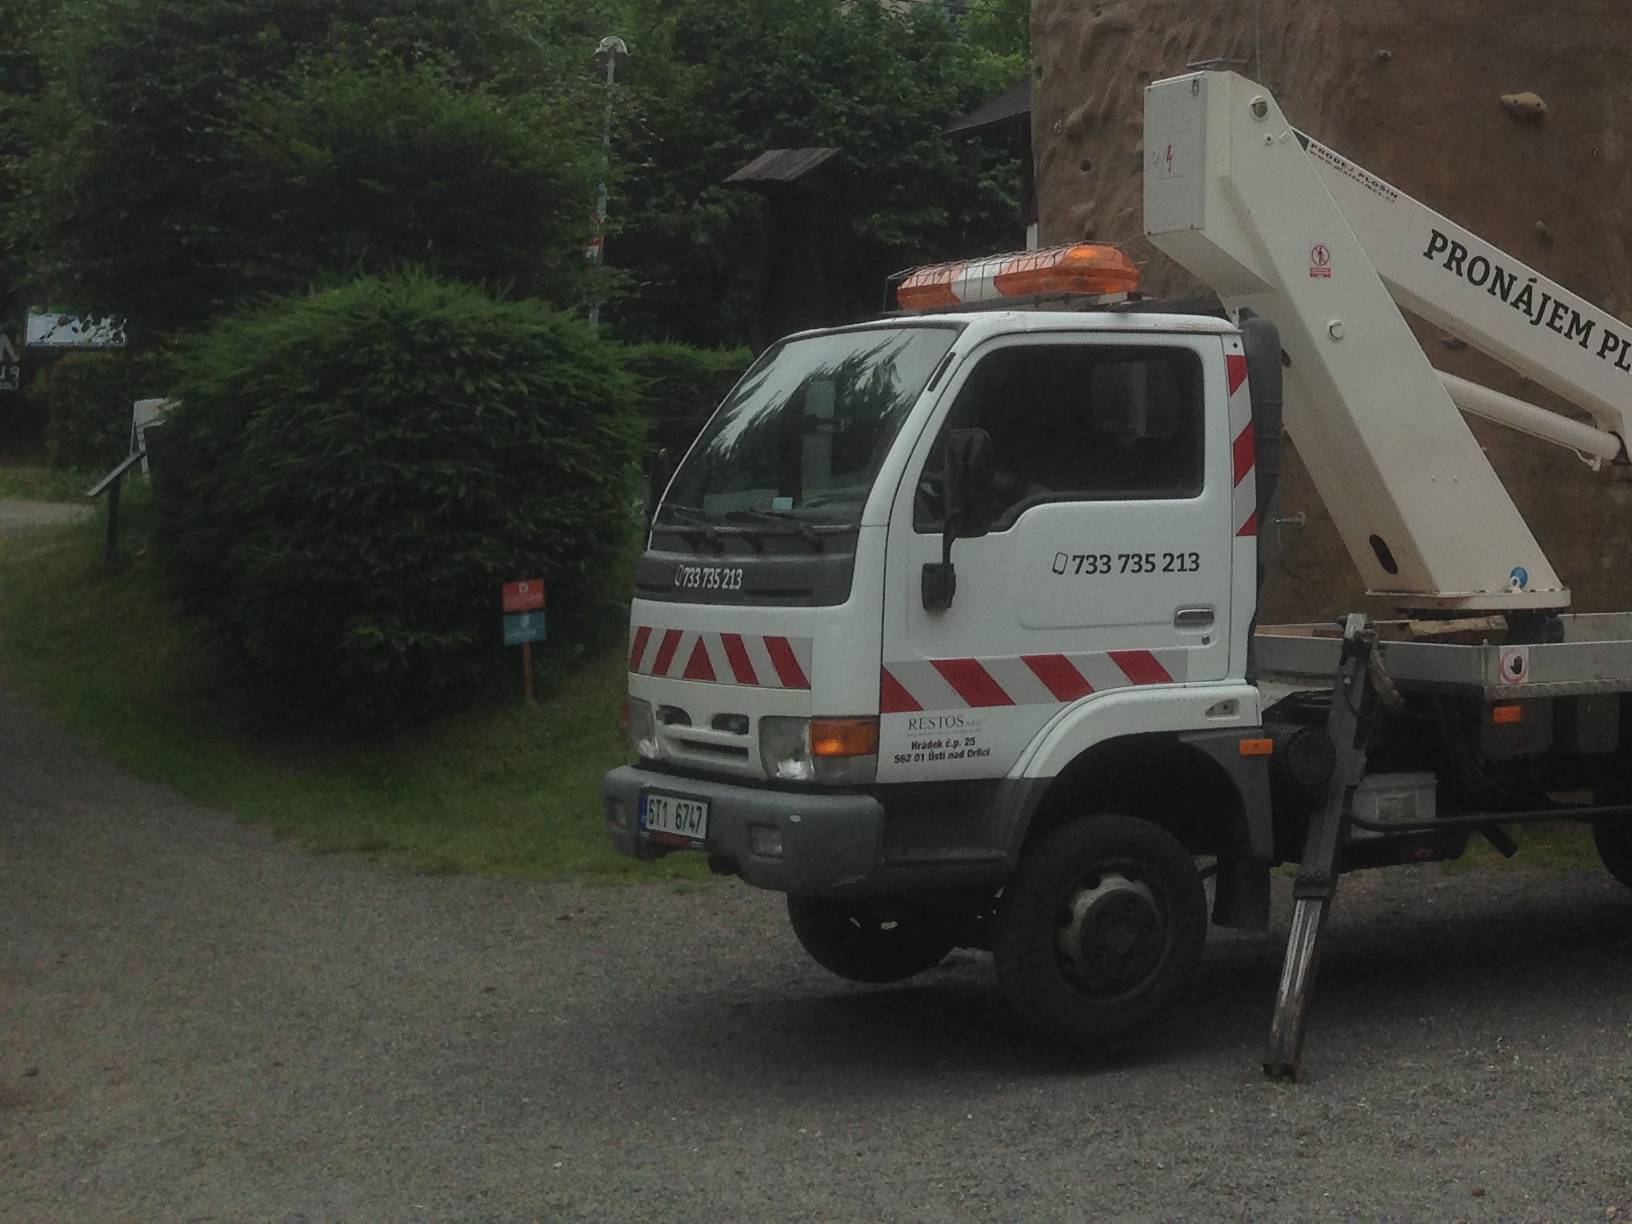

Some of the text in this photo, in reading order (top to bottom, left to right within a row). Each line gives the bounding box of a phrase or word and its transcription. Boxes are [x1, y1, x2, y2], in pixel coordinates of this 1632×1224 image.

[1310, 143, 1355, 173] PRODEJ
[1423, 228, 1596, 349] PRONÁJEM
[1072, 552, 1200, 575] 733 735 213
[683, 567, 743, 590] 733 735 213
[908, 715, 964, 730] RESTOS
[911, 739, 942, 750] Hrádek
[964, 736, 976, 747] 25
[914, 753, 925, 762] 01
[947, 749, 964, 759] nad
[648, 798, 703, 834] 6T1 6747
